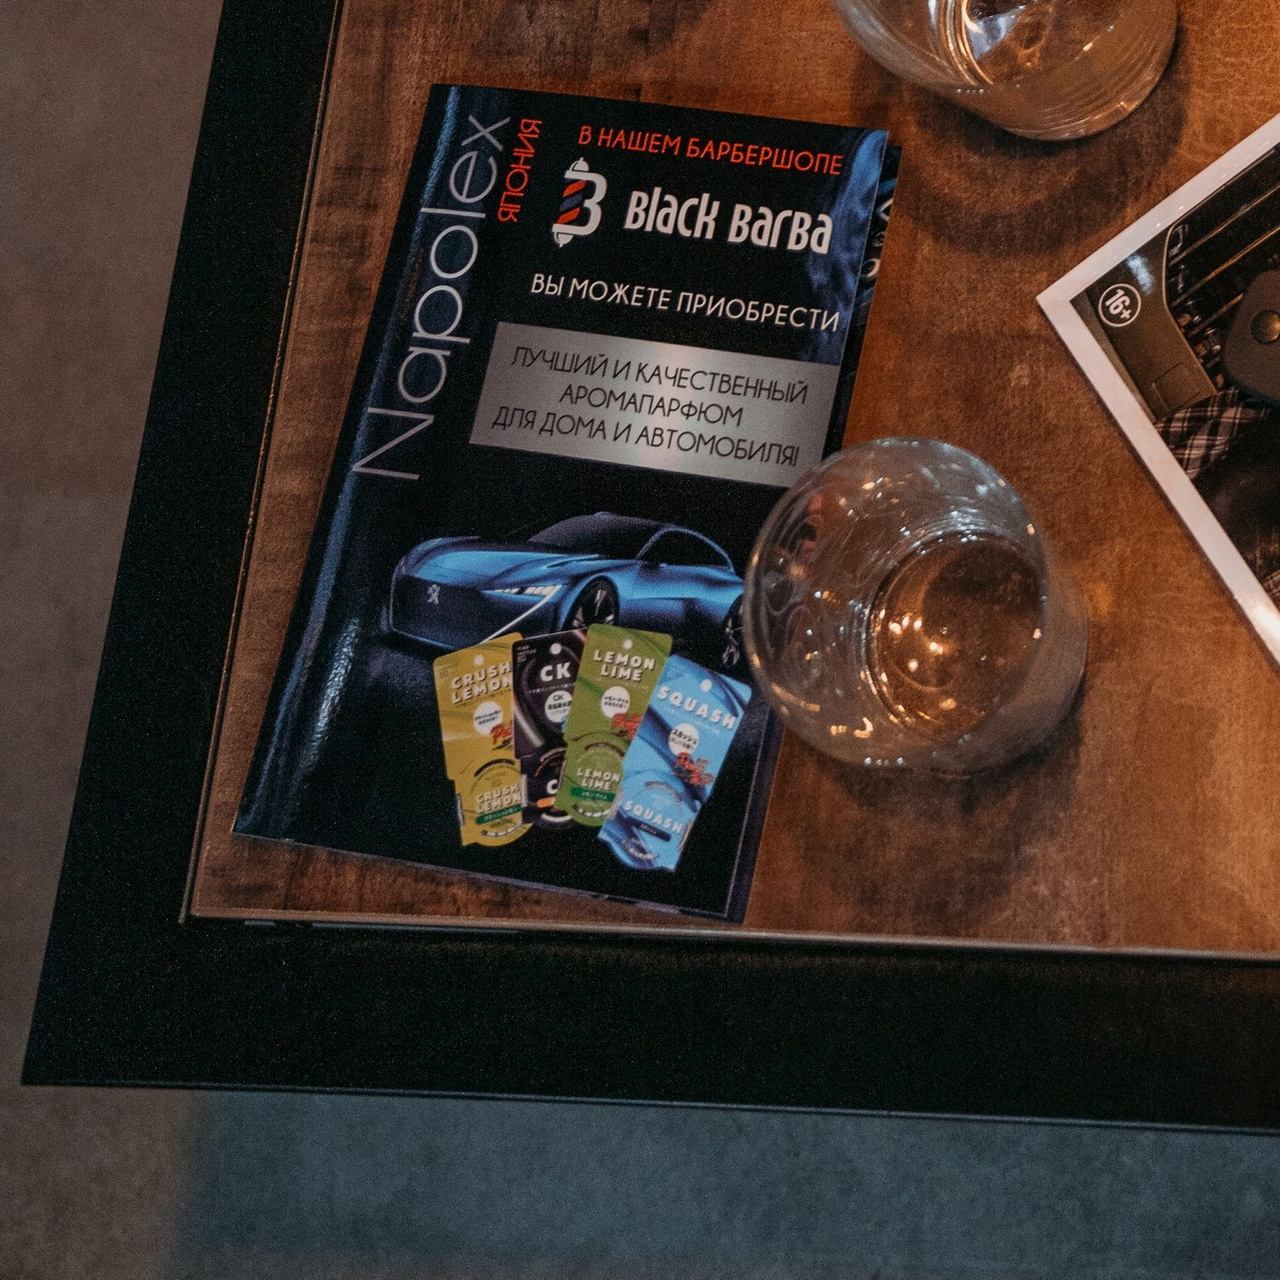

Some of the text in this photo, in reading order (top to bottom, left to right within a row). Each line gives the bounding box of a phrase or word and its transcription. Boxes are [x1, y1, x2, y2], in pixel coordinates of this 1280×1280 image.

[578, 125, 844, 176] В НАШЕМ БАРБЕРШОПЕ
[498, 118, 543, 223] ЯПОНИЯ
[352, 114, 511, 481] Napolex
[530, 274, 841, 332] ВЫ МОЖЕТЕ ПРИОБРЕСТИ
[1104, 288, 1132, 321] 16+
[511, 344, 608, 378] ЛУЧШИЙ
[637, 362, 809, 405] КАЧЕСТВЕННЫЙ
[558, 383, 743, 427] АРОМАПАРФЮМ
[491, 405, 536, 432] ДЛЯ
[540, 411, 607, 440] ДОМА
[635, 425, 800, 468] АВТОМОБИЛЯ!
[452, 661, 512, 690] CRUSH
[540, 661, 571, 682] CK
[593, 649, 656, 671] LEMON
[600, 664, 643, 682] LIME
[452, 676, 513, 704] LEMON
[656, 686, 737, 731] SQUASH
[577, 767, 620, 783] LEMON
[581, 777, 612, 791] LIME
[623, 800, 683, 835] SQUASH
